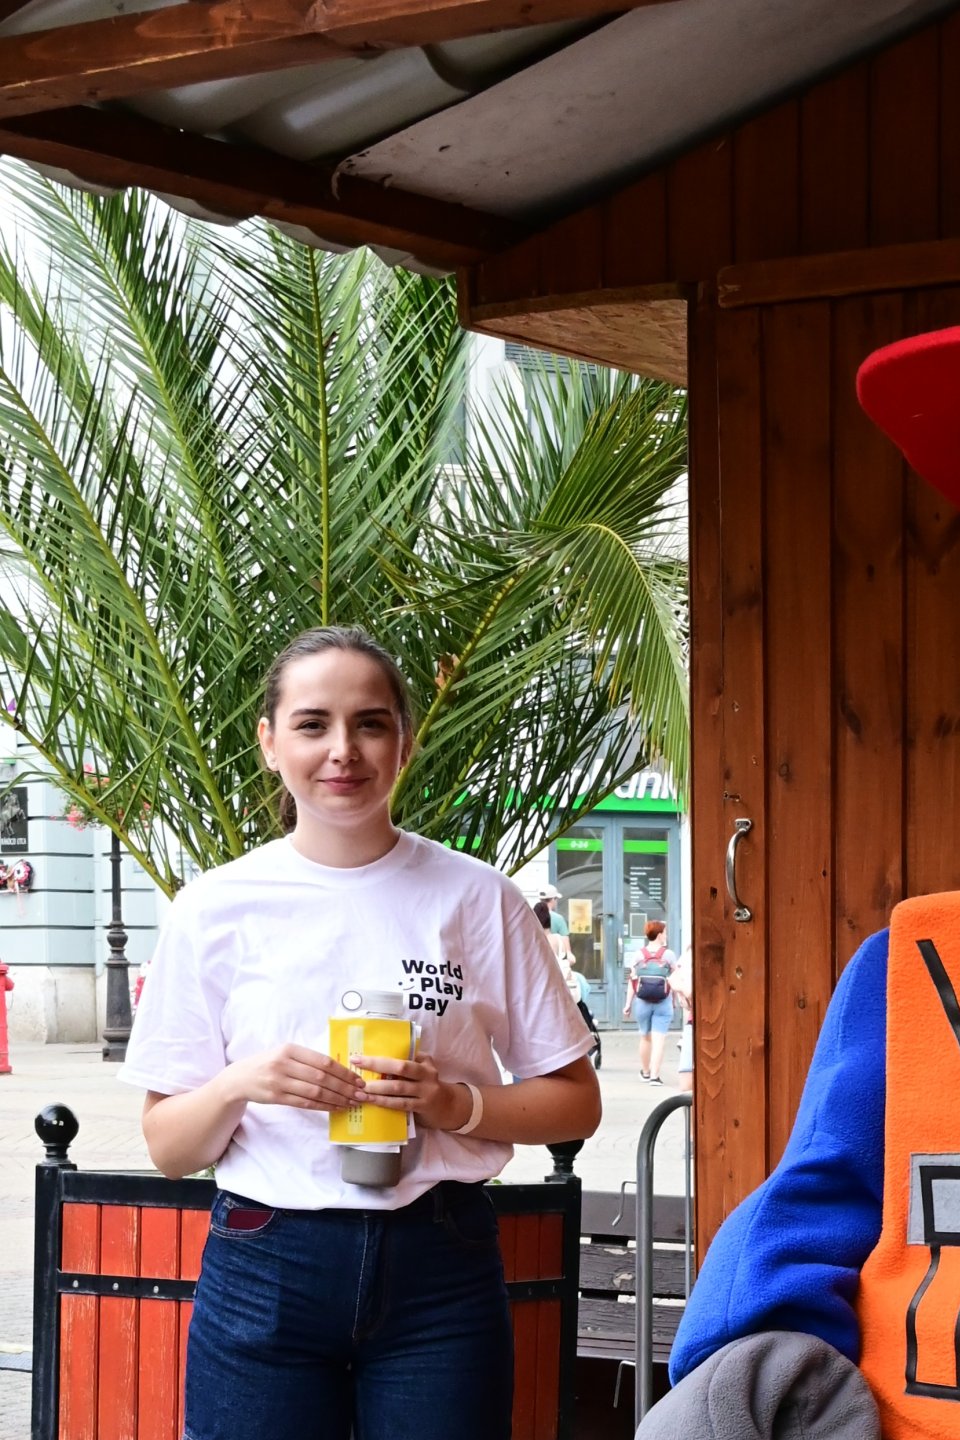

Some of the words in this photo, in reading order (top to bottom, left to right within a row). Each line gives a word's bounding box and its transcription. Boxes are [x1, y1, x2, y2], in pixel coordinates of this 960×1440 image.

[402, 960, 463, 981] World
[421, 977, 463, 1000] Play
[409, 993, 449, 1016] Day
